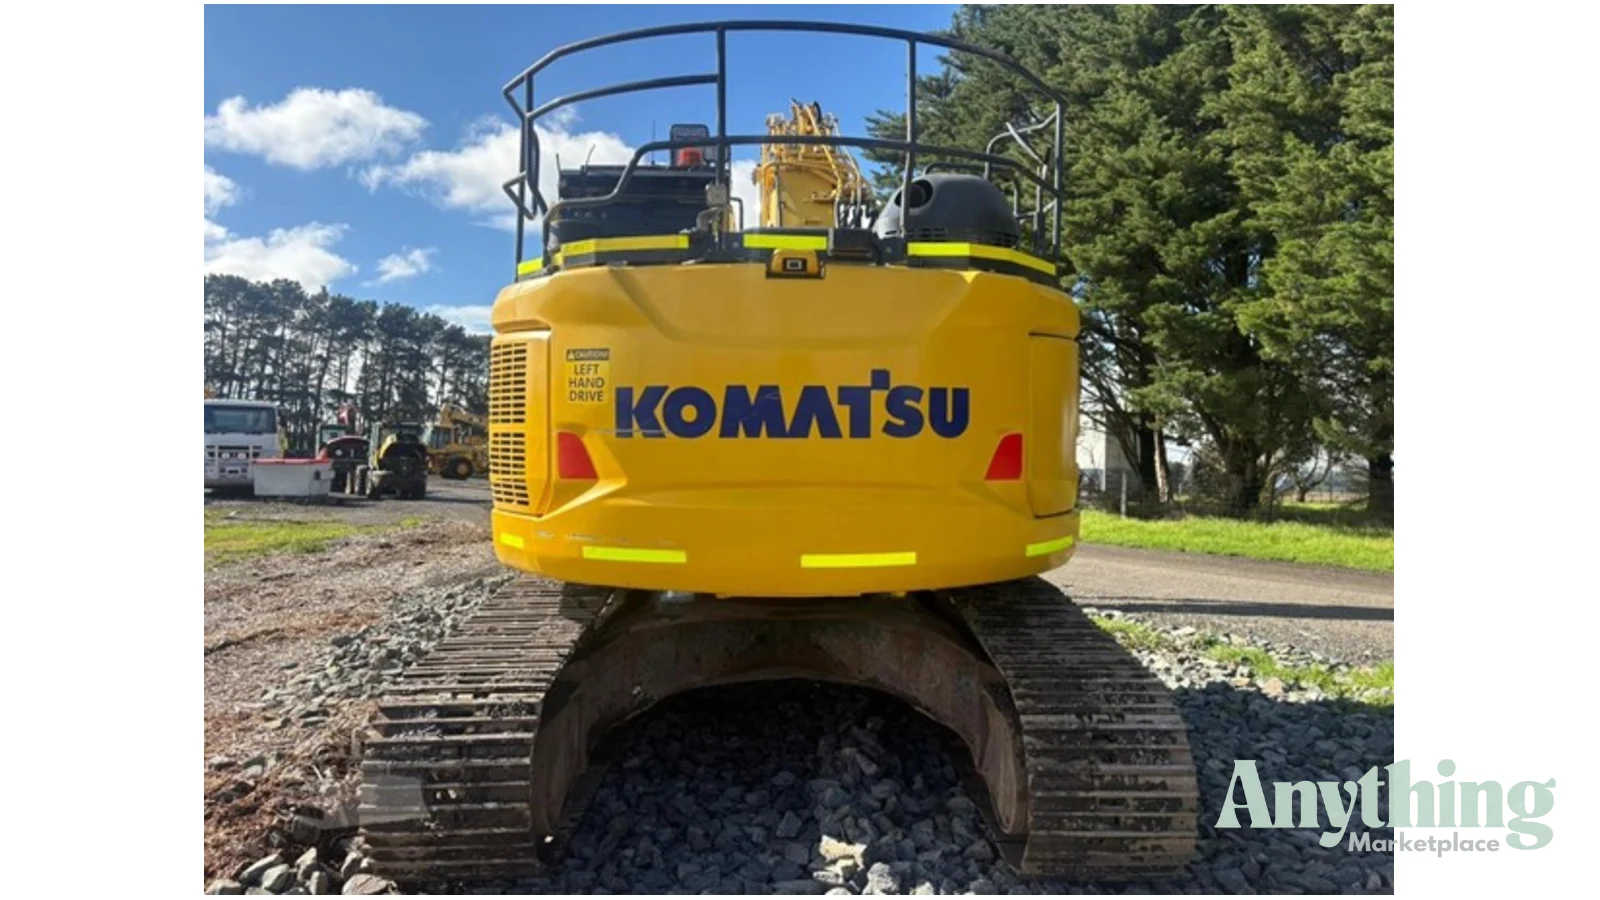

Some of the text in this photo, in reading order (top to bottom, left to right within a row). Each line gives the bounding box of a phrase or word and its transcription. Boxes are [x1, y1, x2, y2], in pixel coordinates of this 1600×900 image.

[574, 364, 600, 375] LEFT
[568, 377, 605, 388] HAND
[569, 390, 604, 402] DRIVE
[615, 369, 970, 439] KOMATSU
